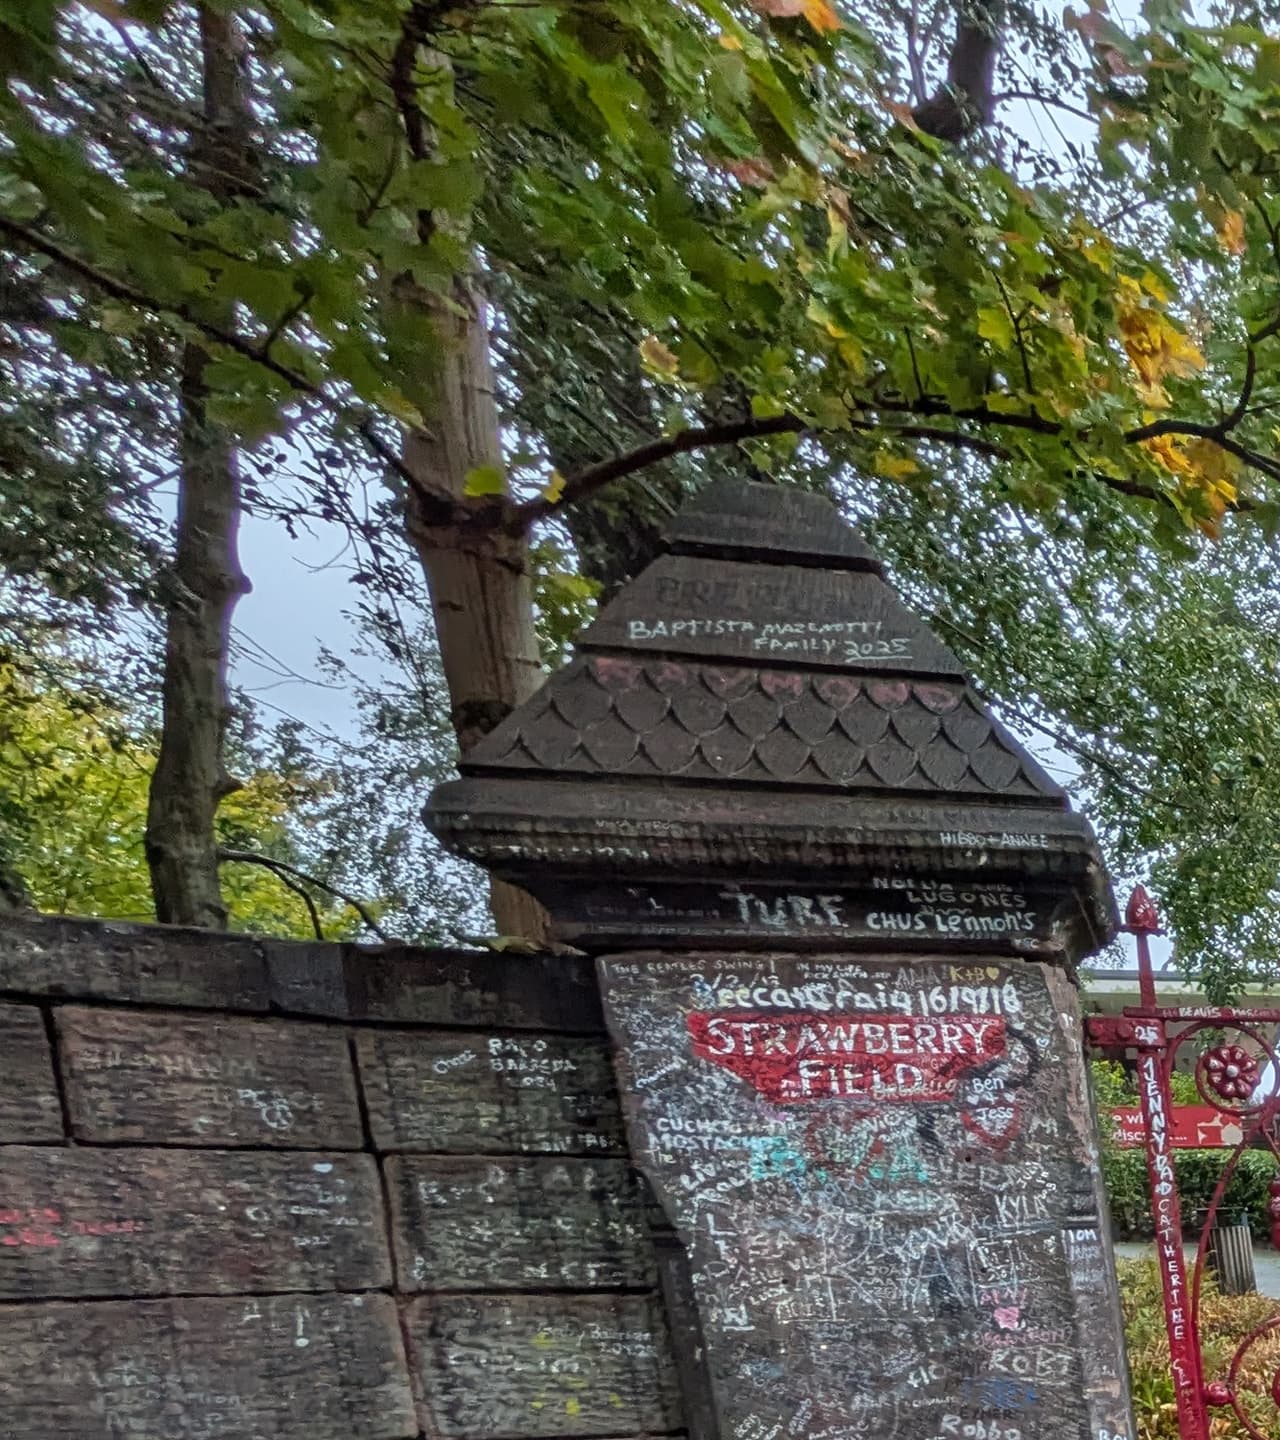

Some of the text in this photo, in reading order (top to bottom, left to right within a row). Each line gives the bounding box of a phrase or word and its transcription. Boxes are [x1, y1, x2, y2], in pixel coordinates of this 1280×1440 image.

[628, 619, 754, 640] BAPTISTA
[906, 890, 1027, 908] LUGONES
[708, 1018, 989, 1056] STRAWBERRY
[798, 1059, 924, 1095] FIELD
[971, 1077, 1005, 1093] Ben
[1143, 1056, 1167, 1152] JENNY
